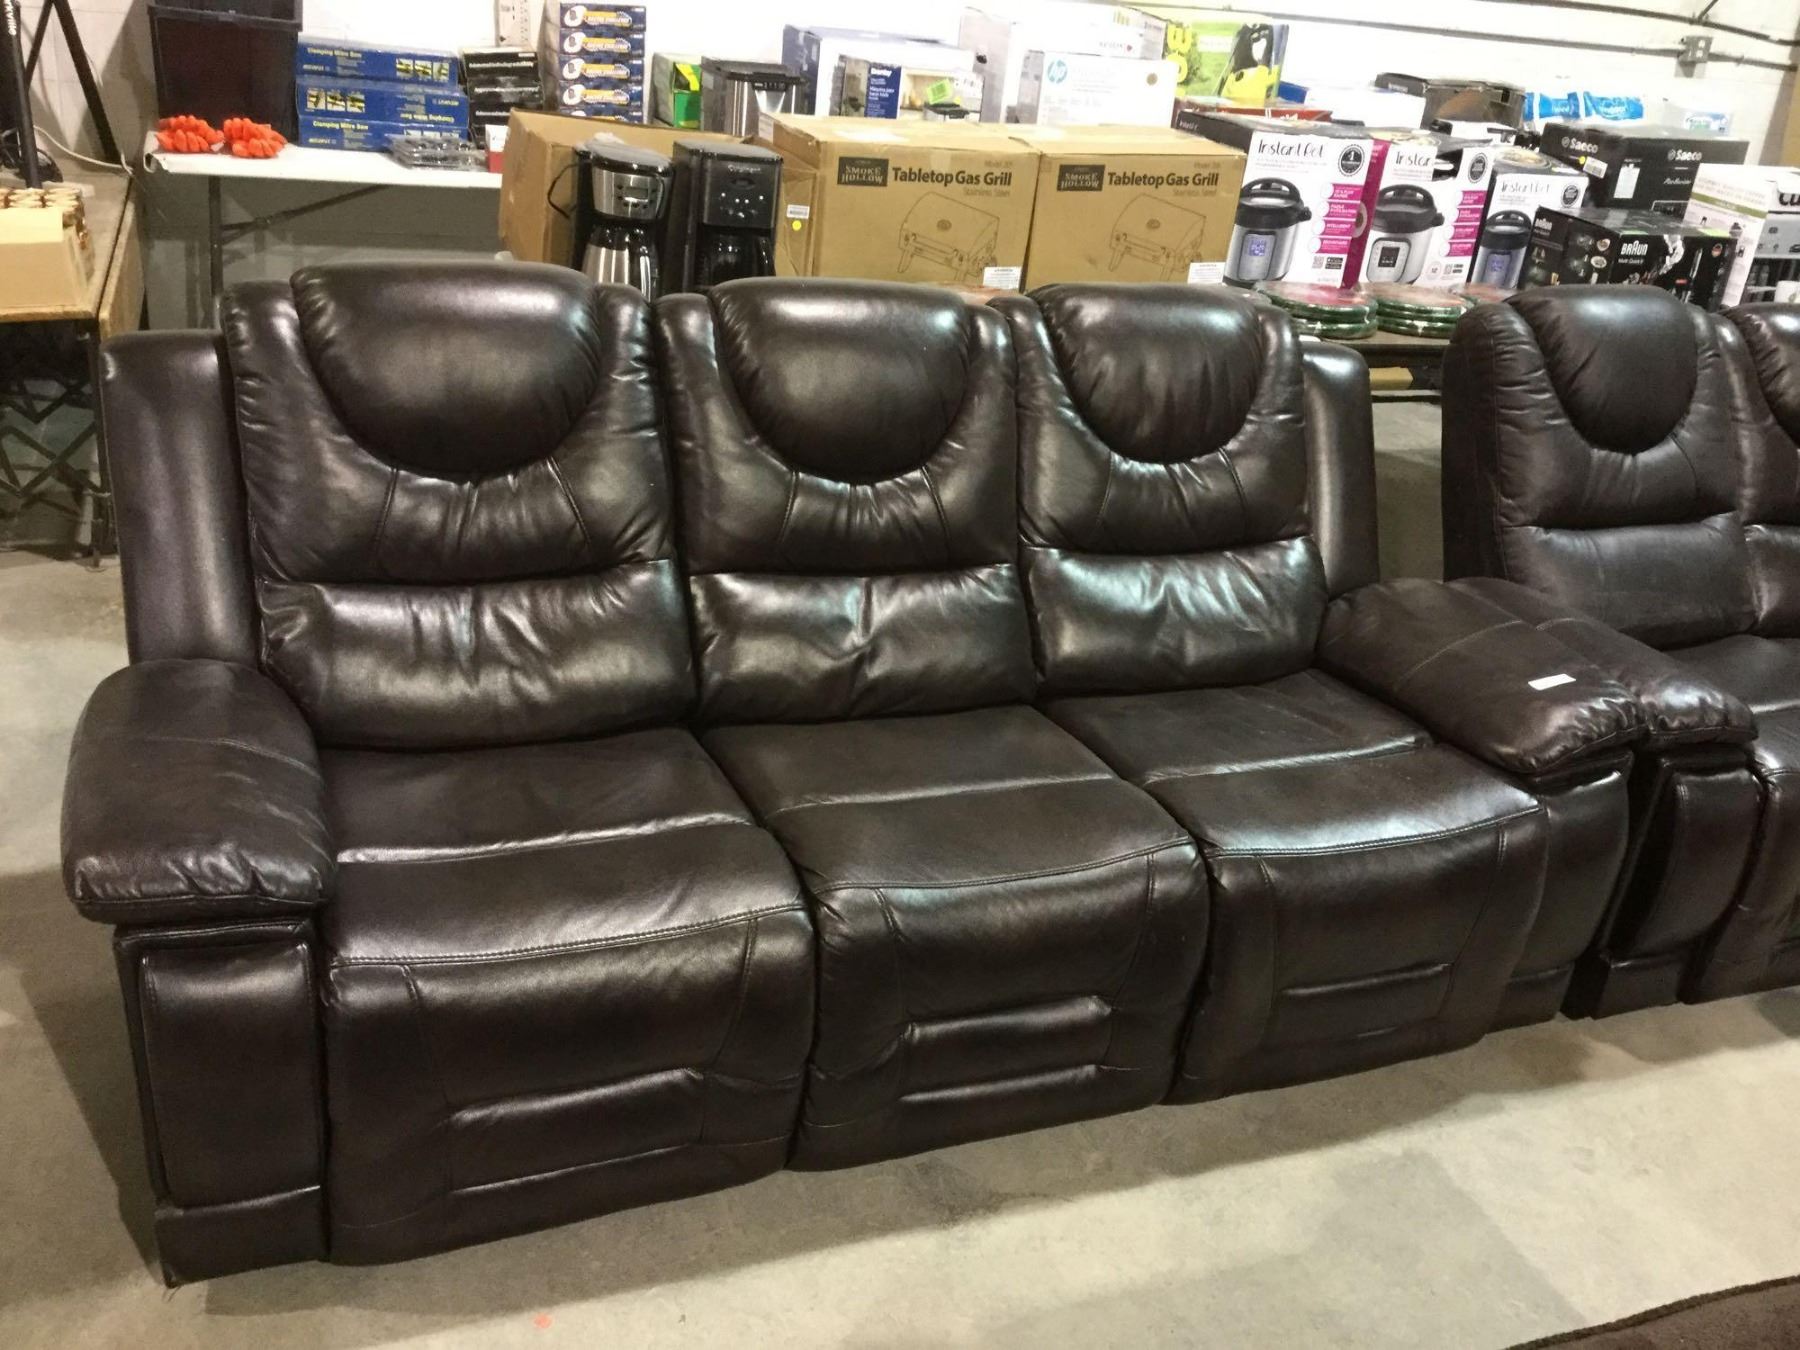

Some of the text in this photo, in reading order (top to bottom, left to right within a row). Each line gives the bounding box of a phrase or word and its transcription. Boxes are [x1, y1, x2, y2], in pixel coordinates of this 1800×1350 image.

[1569, 137, 1599, 154] Saeco
[1674, 149, 1702, 161] Saeco
[892, 167, 1012, 187] Tabletop Gas Grill
[1108, 172, 1219, 189] Tabletop Gas Grill
[1620, 240, 1648, 256] BRAUN
